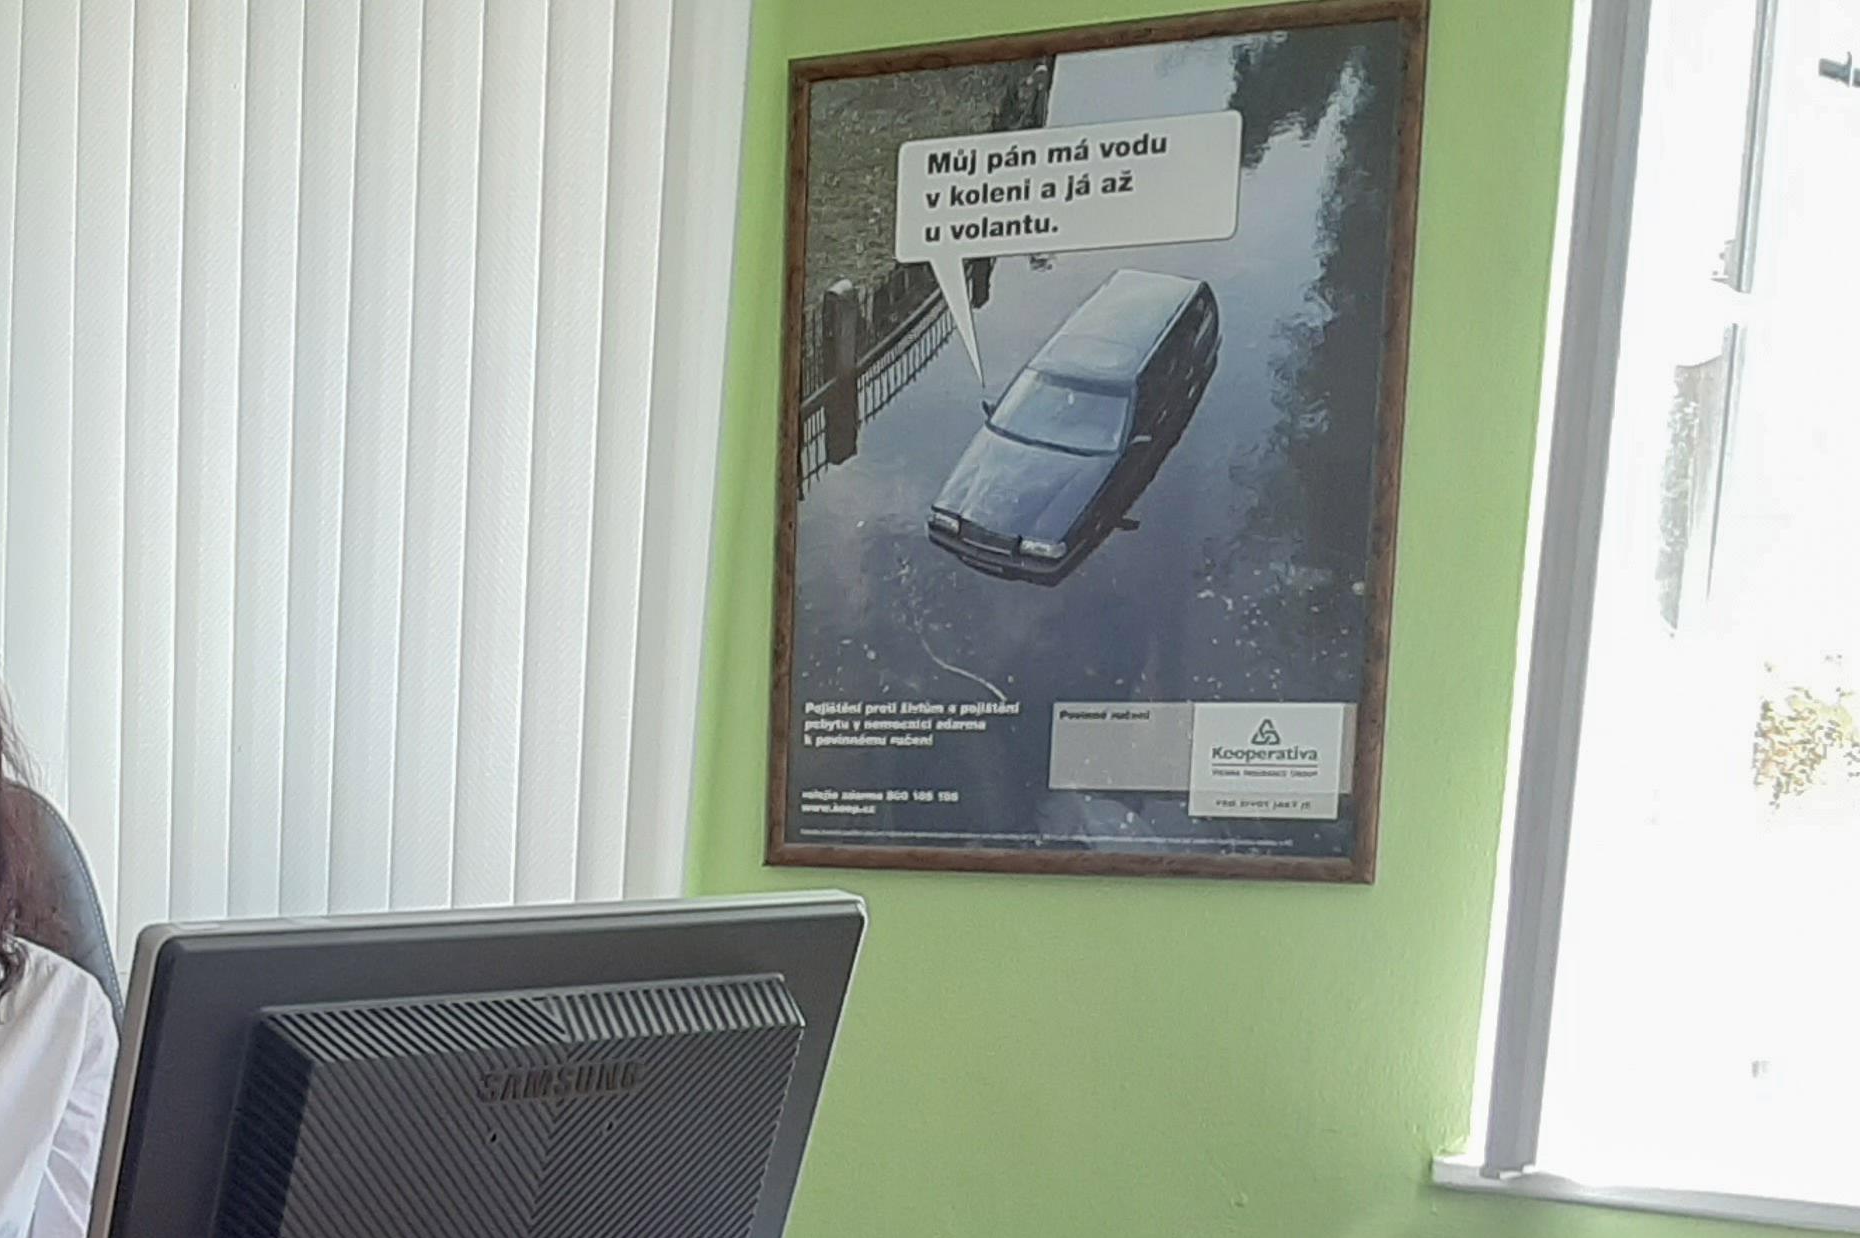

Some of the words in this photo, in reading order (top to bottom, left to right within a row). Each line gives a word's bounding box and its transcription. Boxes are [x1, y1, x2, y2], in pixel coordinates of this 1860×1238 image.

[927, 149, 977, 175] Můj
[987, 145, 1037, 173] pán
[1047, 138, 1089, 164] má
[1099, 133, 1168, 158] vodu
[926, 192, 941, 208] v
[1041, 181, 1056, 200] a
[1064, 173, 1091, 203] já
[1101, 169, 1133, 194] až
[924, 225, 941, 242] u
[950, 216, 1059, 240] volantu.
[1211, 746, 1318, 763] Kooperativa
[478, 1062, 637, 1101] SAMSUNG
